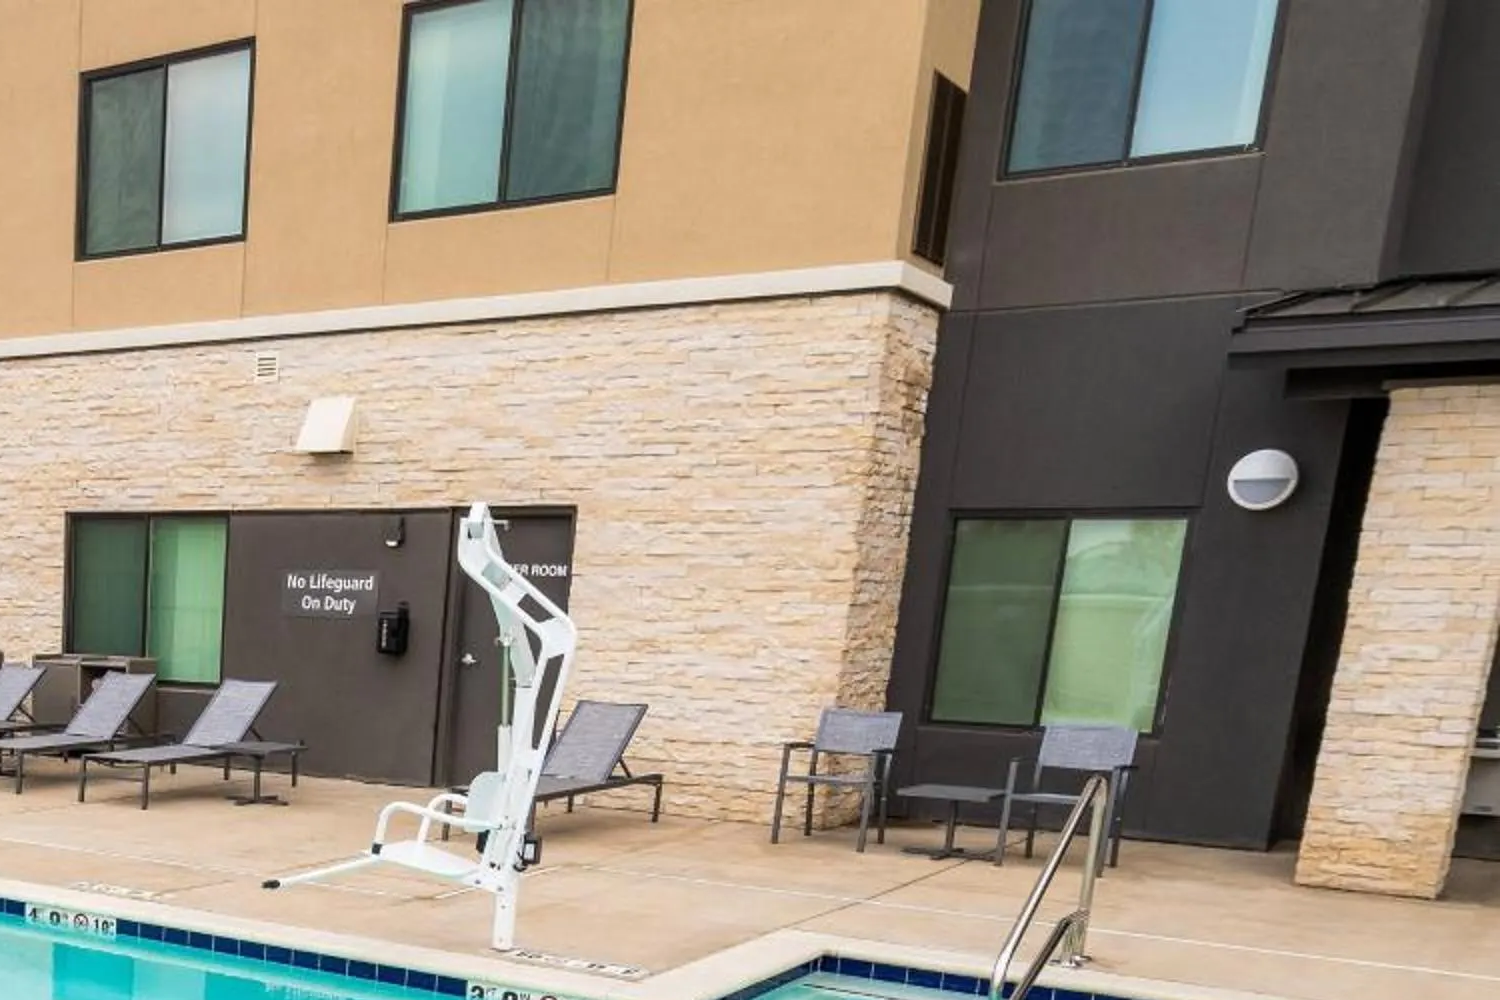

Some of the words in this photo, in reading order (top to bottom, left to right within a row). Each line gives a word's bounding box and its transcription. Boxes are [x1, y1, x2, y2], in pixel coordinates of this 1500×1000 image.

[531, 564, 568, 576] ROOM
[287, 573, 306, 589] No
[310, 573, 374, 592] Lifeguard
[301, 595, 321, 609] On
[324, 595, 356, 615] Duty
